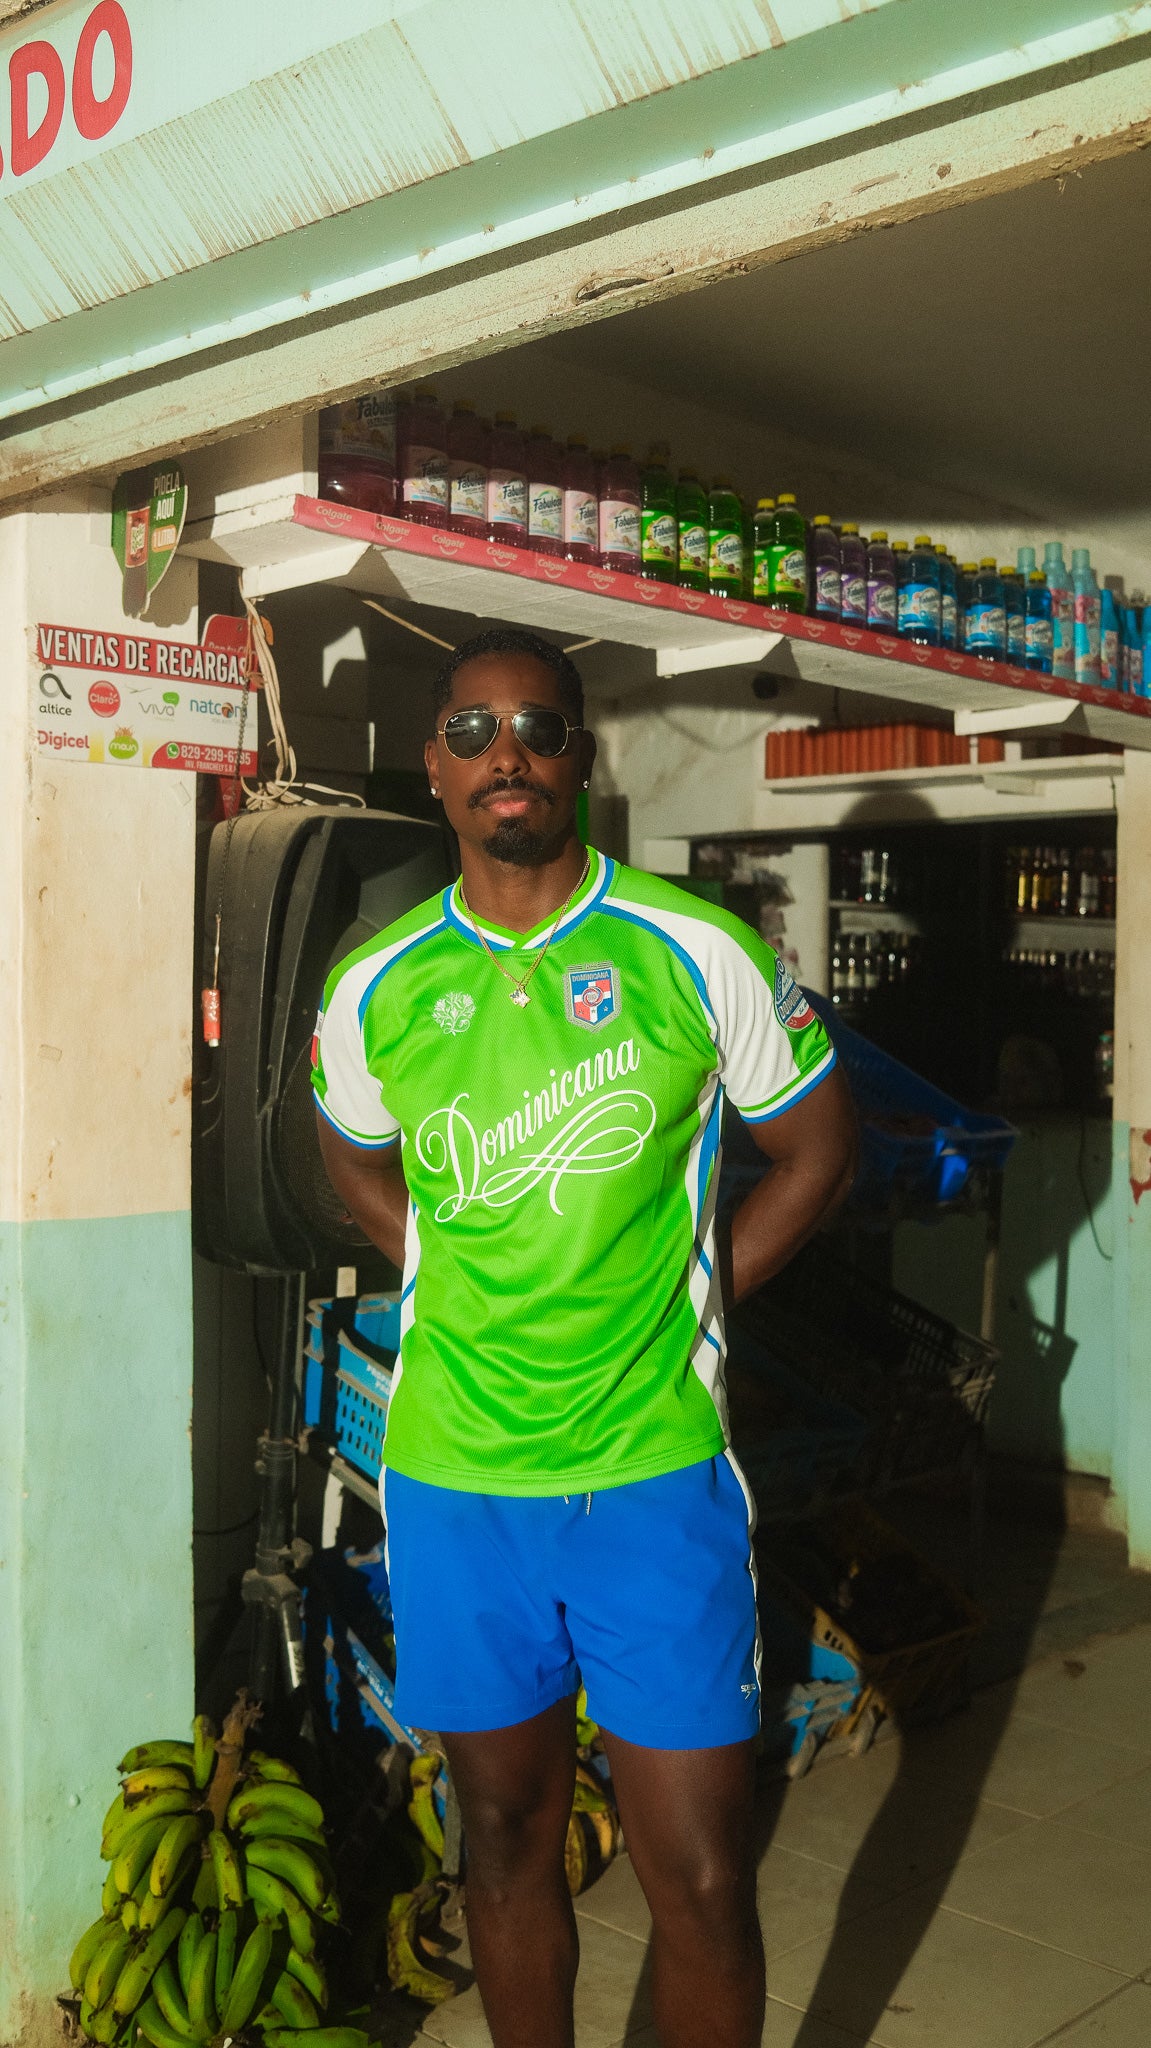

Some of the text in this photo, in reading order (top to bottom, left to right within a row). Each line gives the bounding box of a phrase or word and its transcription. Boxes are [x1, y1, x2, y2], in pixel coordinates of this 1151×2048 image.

[0, 0, 133, 180] DO
[156, 493, 176, 520] AQUÍ
[316, 505, 352, 521] Colgate
[376, 522, 411, 536] Colgate
[431, 534, 465, 549] Colgate
[487, 547, 518, 560] Colgate
[538, 559, 568, 572] Colgate
[40, 627, 120, 668] VENTAS
[124, 639, 151, 672] DE
[90, 692, 115, 705] Claro
[40, 703, 72, 716] altice
[138, 702, 175, 717] viva
[38, 730, 90, 750] Digicel
[416, 1038, 656, 1223] Dominicana
